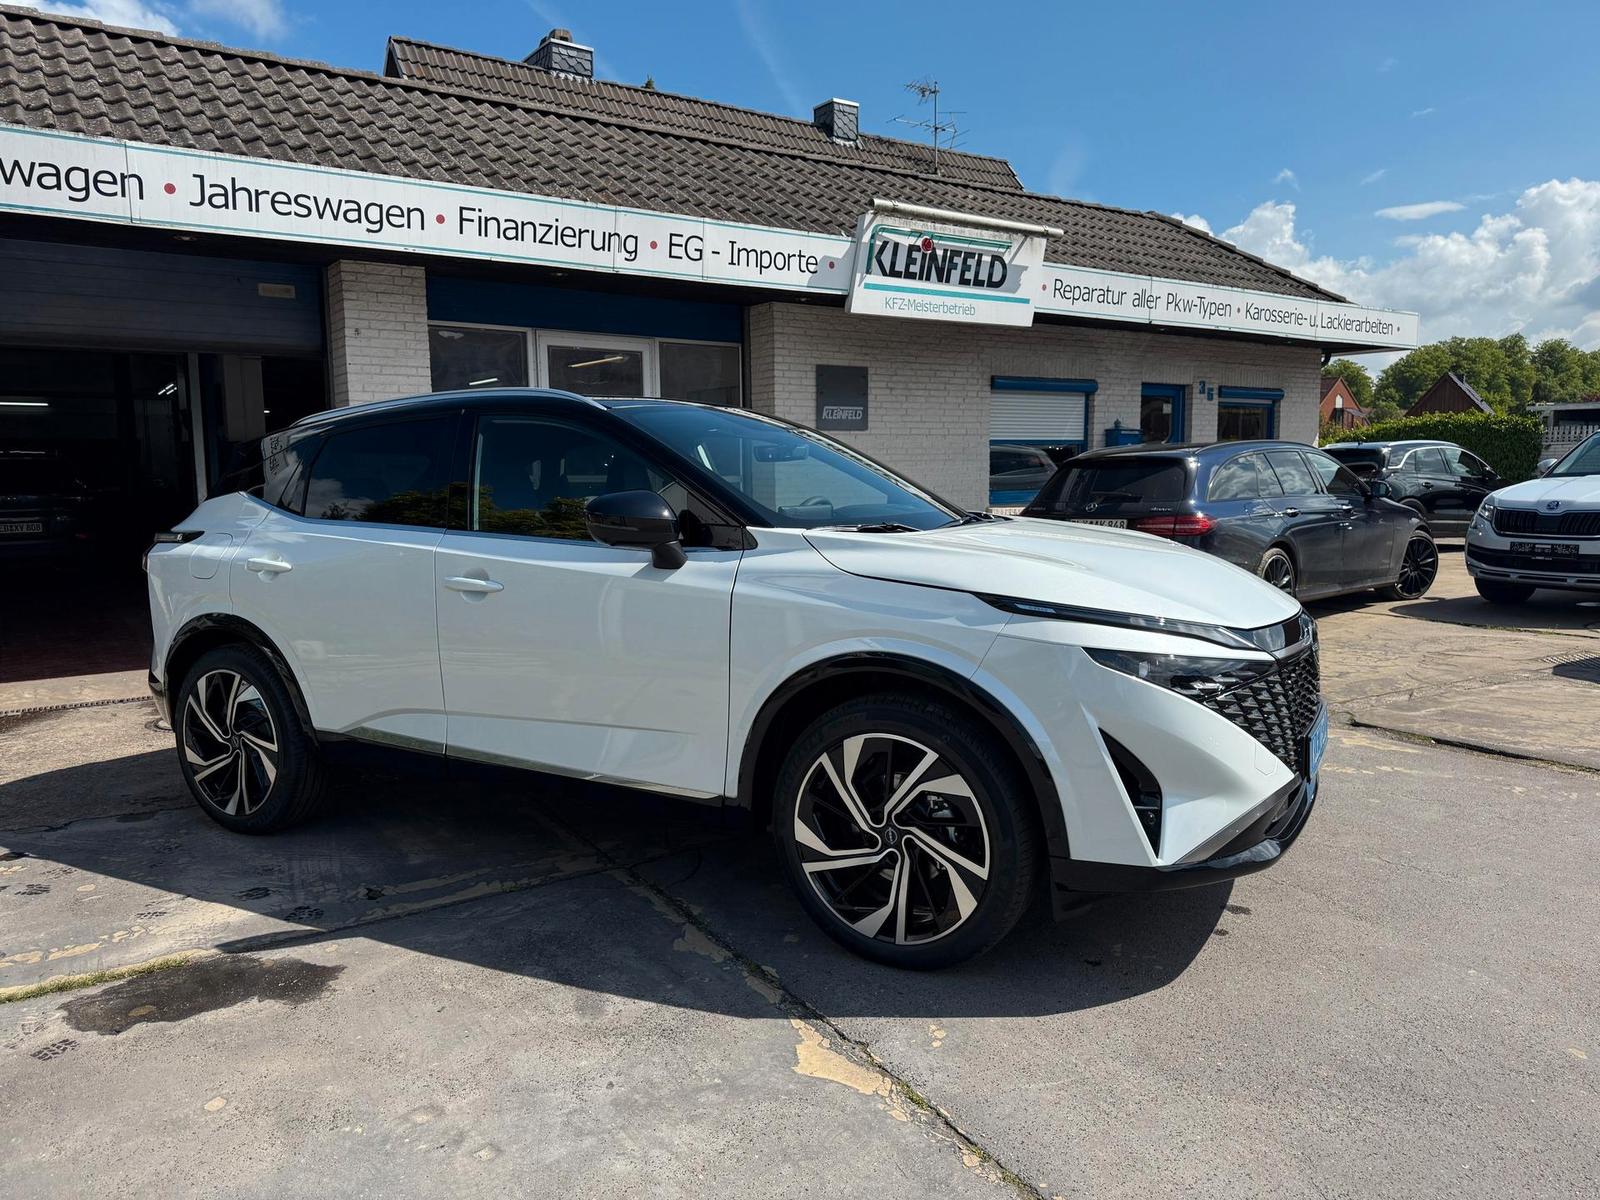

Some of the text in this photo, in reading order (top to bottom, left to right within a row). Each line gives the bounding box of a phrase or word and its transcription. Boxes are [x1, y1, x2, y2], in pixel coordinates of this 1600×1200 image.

[0, 157, 143, 203] wagen
[189, 173, 425, 234] Jahreswagen
[459, 206, 639, 262] Finanzierung
[668, 232, 704, 262] EG
[728, 240, 819, 275] Importe
[874, 238, 1008, 289] KLEINFELD
[884, 297, 976, 316] KFZ-Meisterbetrieb
[1053, 278, 1127, 306] Reparatur
[1132, 288, 1161, 311] aller
[1166, 292, 1232, 320] Pkw-Typen
[1320, 312, 1394, 335] Lackierarbeiten
[822, 408, 863, 420] KLEINFELD
